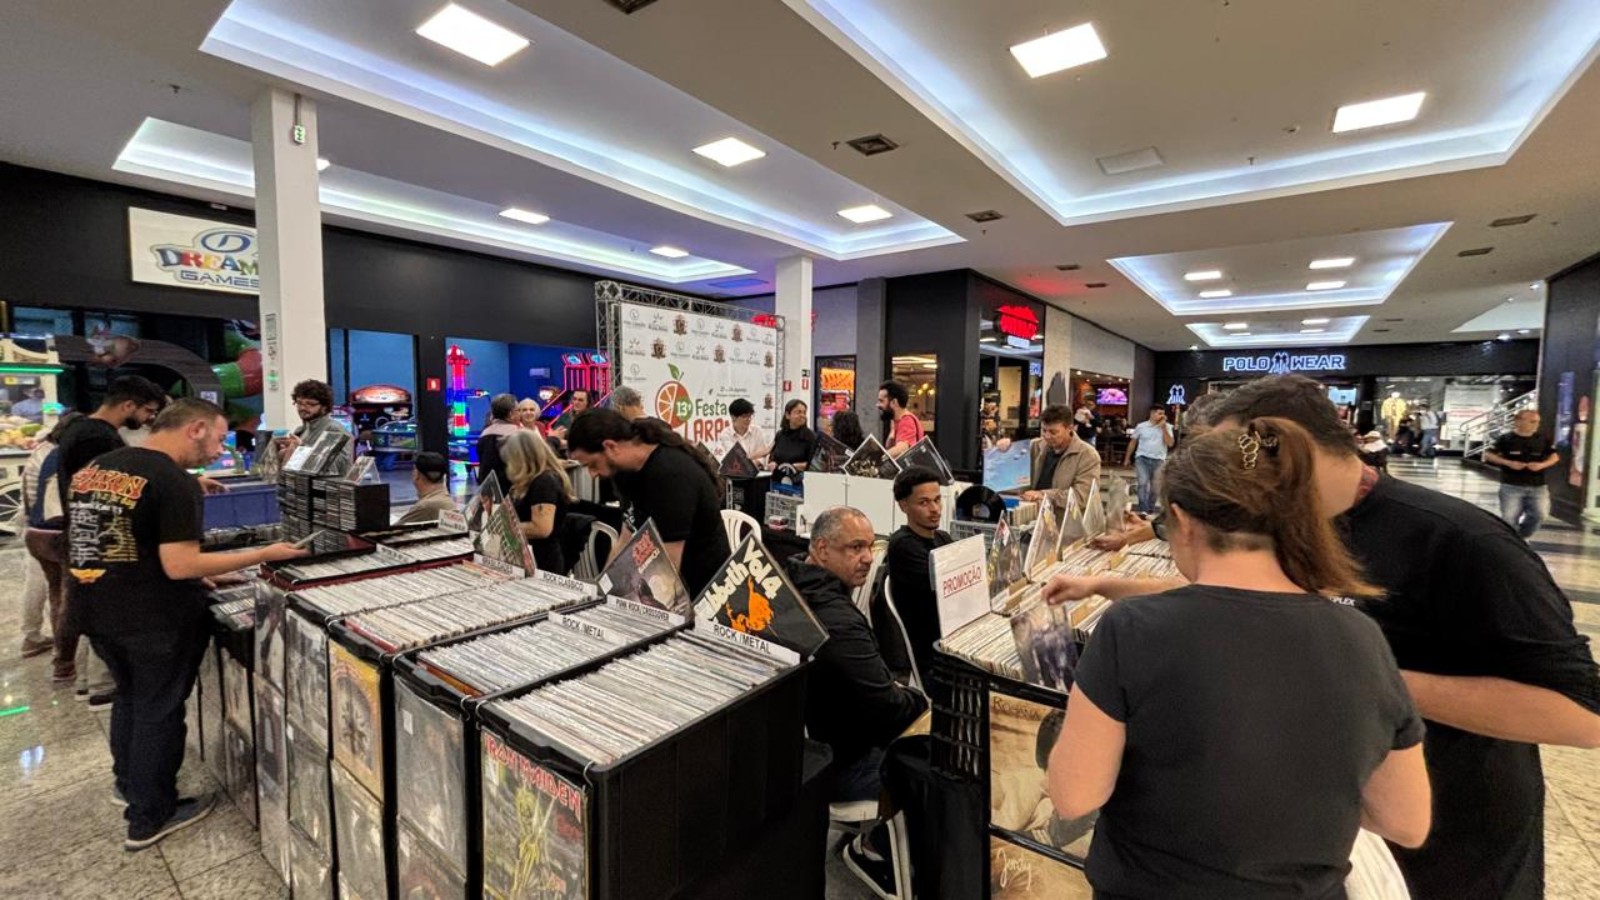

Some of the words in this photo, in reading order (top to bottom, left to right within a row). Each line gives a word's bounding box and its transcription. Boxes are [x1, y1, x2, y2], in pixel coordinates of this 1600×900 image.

[1223, 356, 1270, 372] POLO
[1290, 354, 1346, 370] WEAR
[695, 398, 727, 417] Festa
[761, 575, 783, 600] 4
[942, 564, 982, 594] PROMOÇÃO
[562, 616, 581, 630] ROCK
[714, 624, 739, 643] ROCK
[485, 732, 519, 780] IRON
[519, 756, 582, 824] MAIDEN
